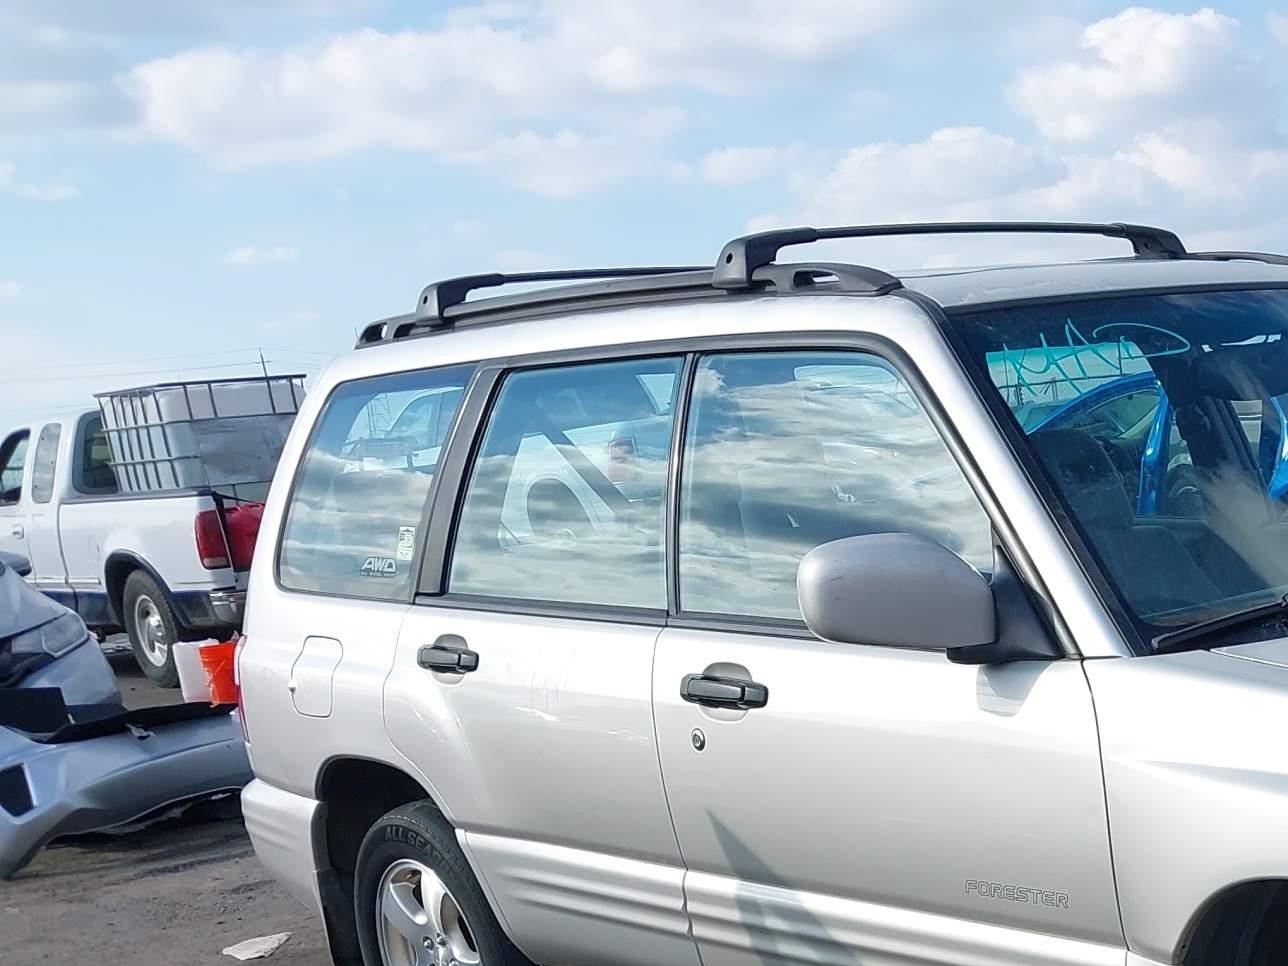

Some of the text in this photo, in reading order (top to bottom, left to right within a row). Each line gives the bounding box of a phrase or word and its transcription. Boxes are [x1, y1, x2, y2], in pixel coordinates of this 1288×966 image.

[361, 557, 396, 572] AWD
[384, 825, 406, 842] ALL
[964, 879, 1070, 909] FORESTER
